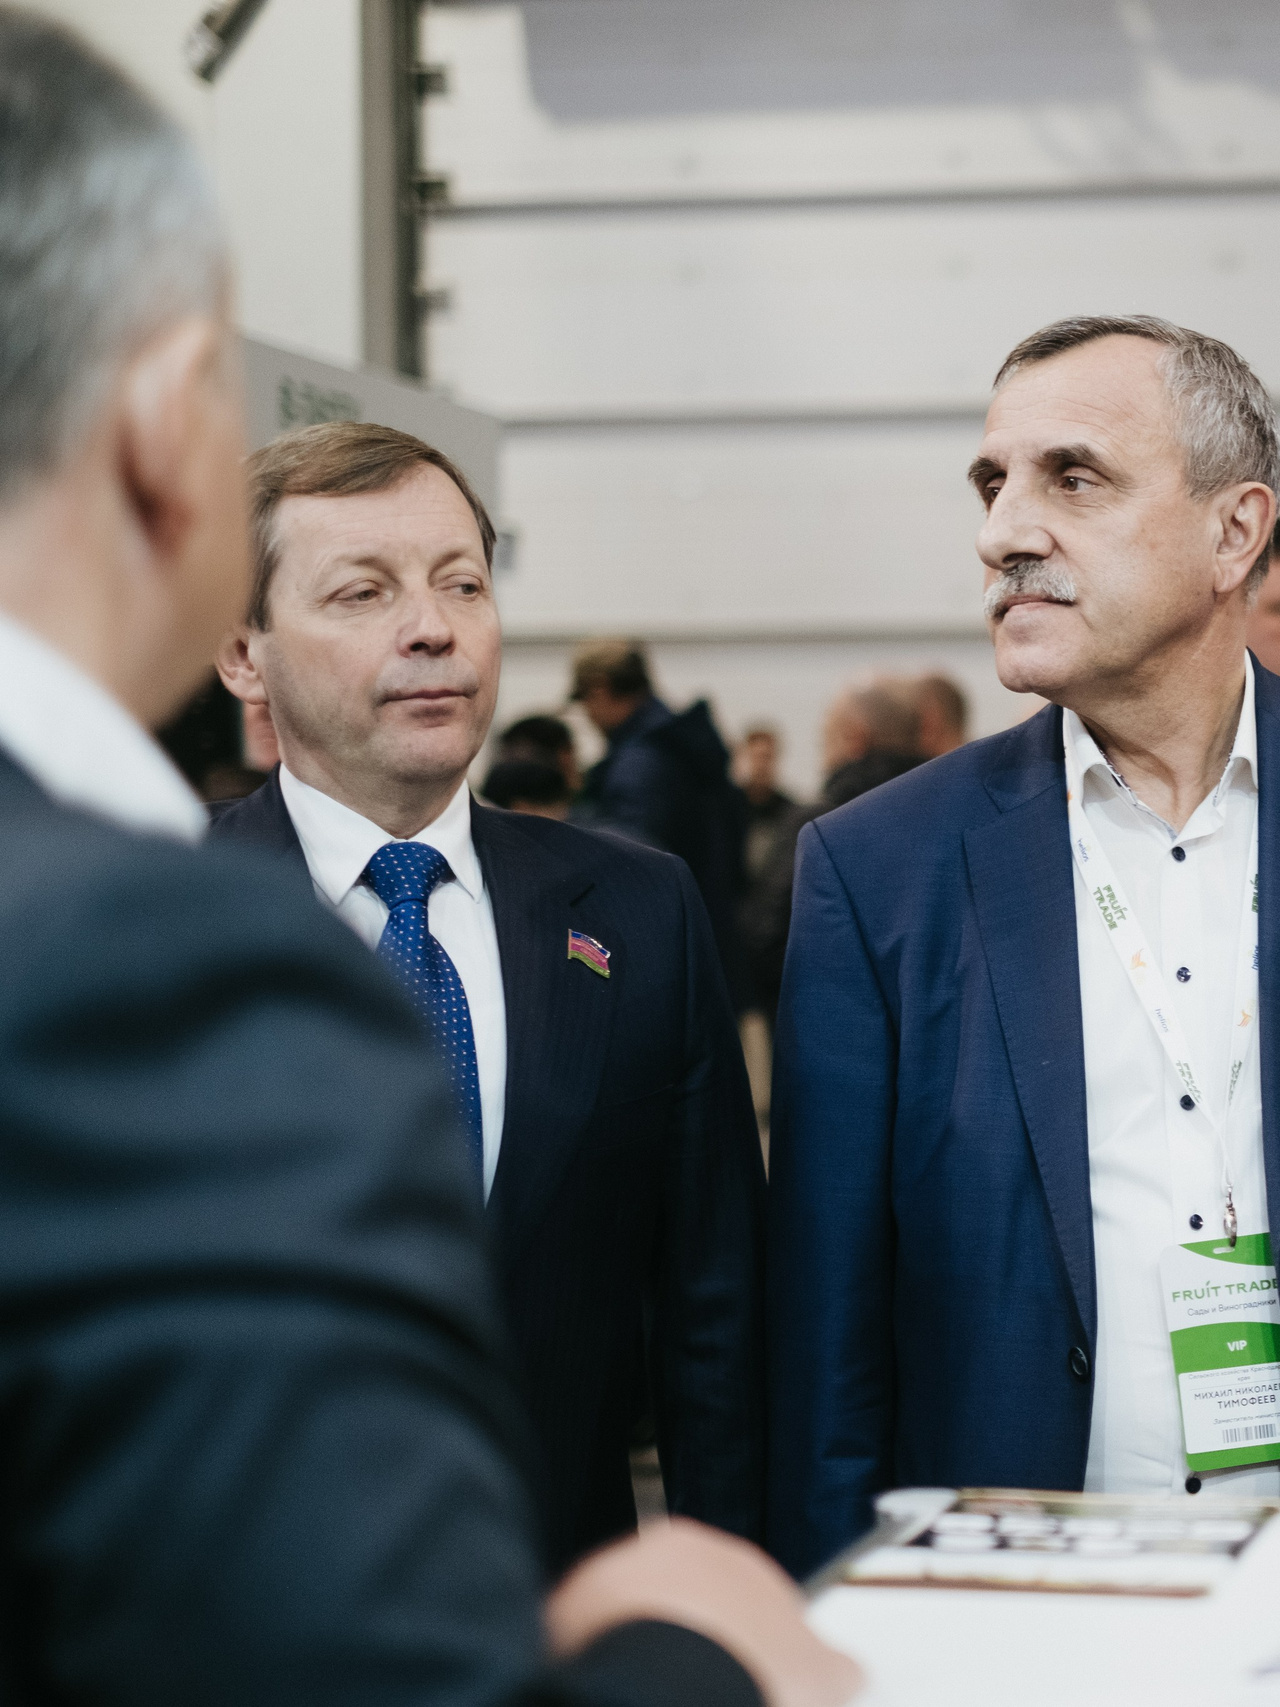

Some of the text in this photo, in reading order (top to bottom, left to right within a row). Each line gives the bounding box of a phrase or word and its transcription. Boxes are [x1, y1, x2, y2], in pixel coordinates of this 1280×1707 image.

[1092, 886, 1118, 931] TRADE
[1155, 1008, 1169, 1033] helios
[1187, 1306, 1210, 1317] Сады
[1218, 1299, 1277, 1312] Виноградники
[1227, 1339, 1248, 1352] VIP
[1194, 1389, 1233, 1400] МИХАИЛ
[1217, 1394, 1277, 1410] ТИМОФЕЕВ
